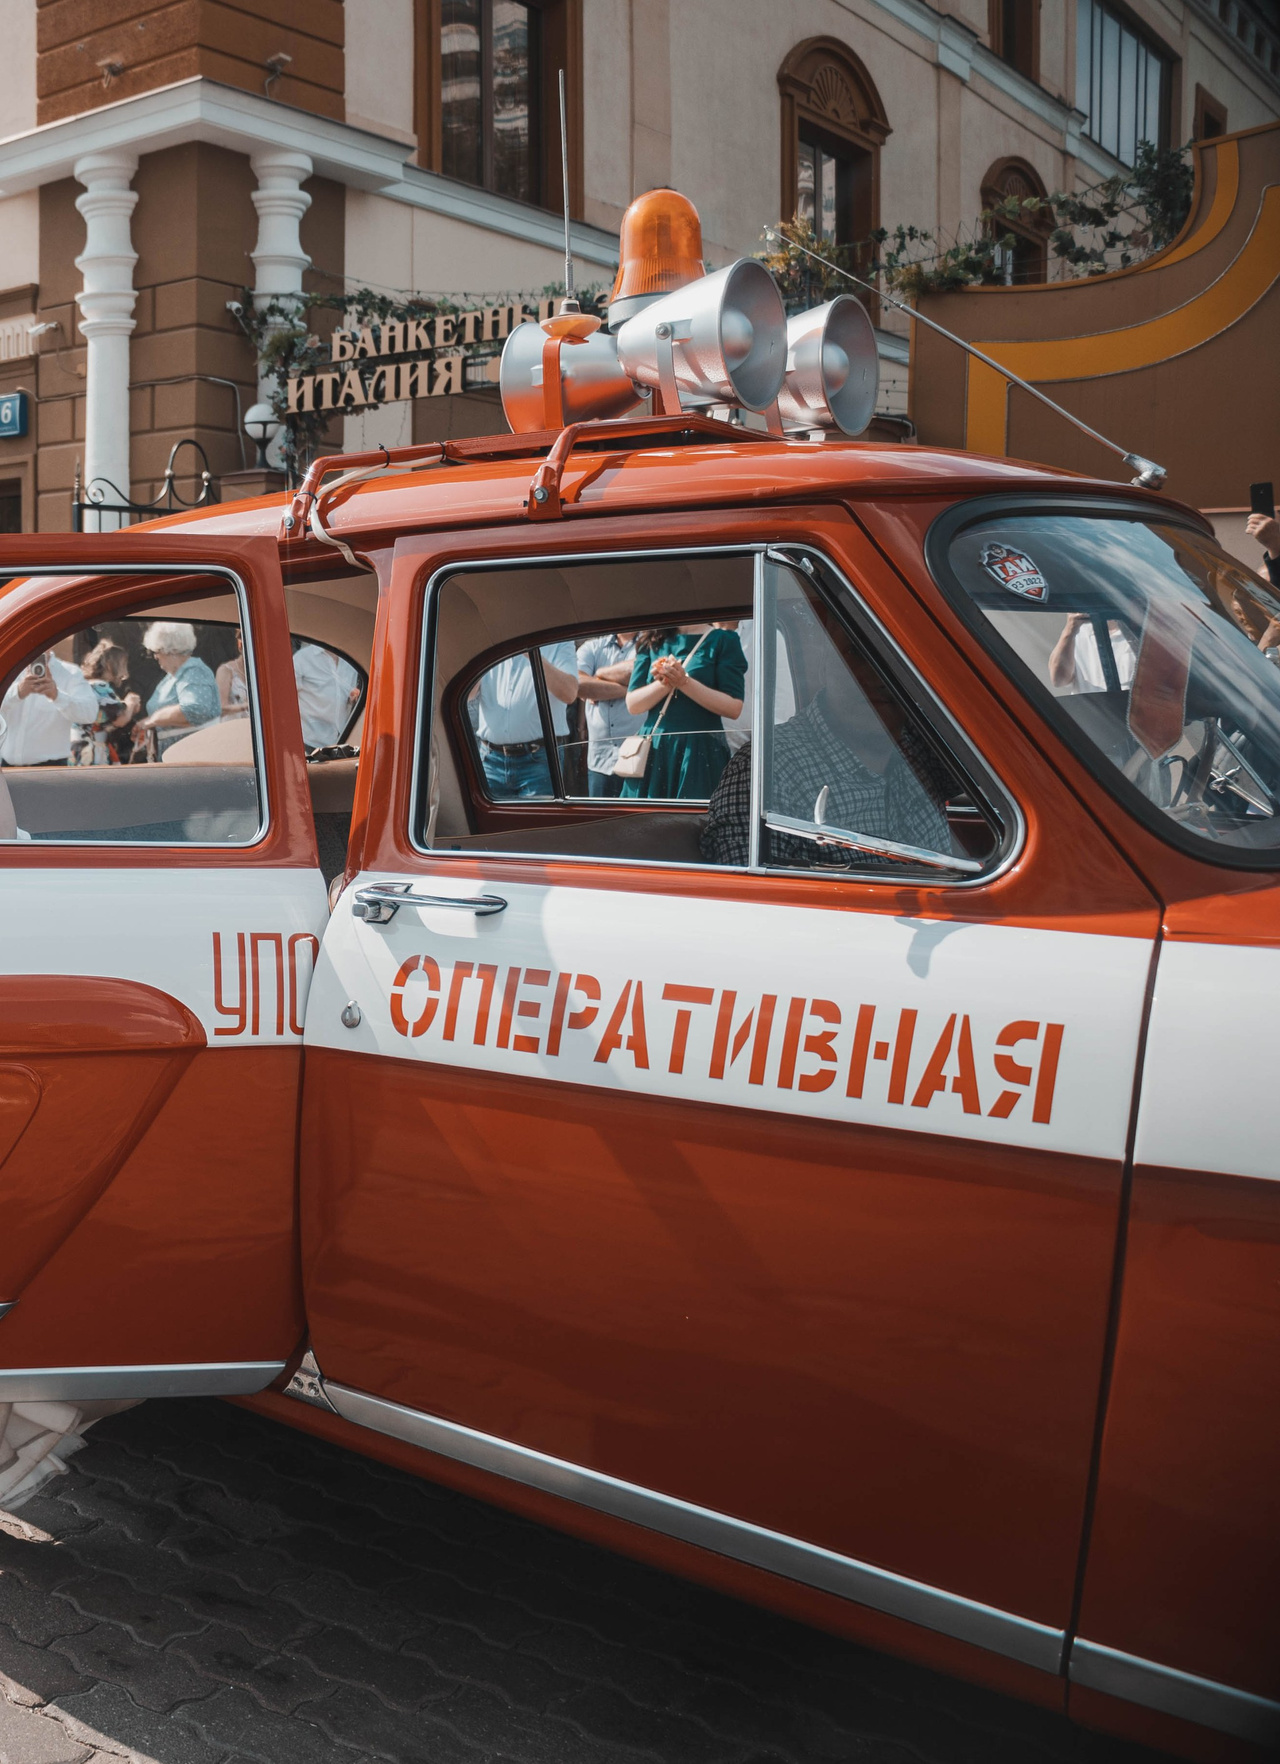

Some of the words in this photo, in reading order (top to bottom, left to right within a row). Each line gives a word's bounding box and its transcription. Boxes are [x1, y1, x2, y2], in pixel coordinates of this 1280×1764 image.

[331, 297, 568, 363] БАНКЕТНЫ
[286, 356, 465, 414] ИТАЛИЯ
[0, 401, 12, 424] 6
[991, 557, 1037, 579] ГАИ
[1023, 577, 1043, 586] 2022
[390, 954, 1065, 1125] ОПЕРАТИВНАЯ
